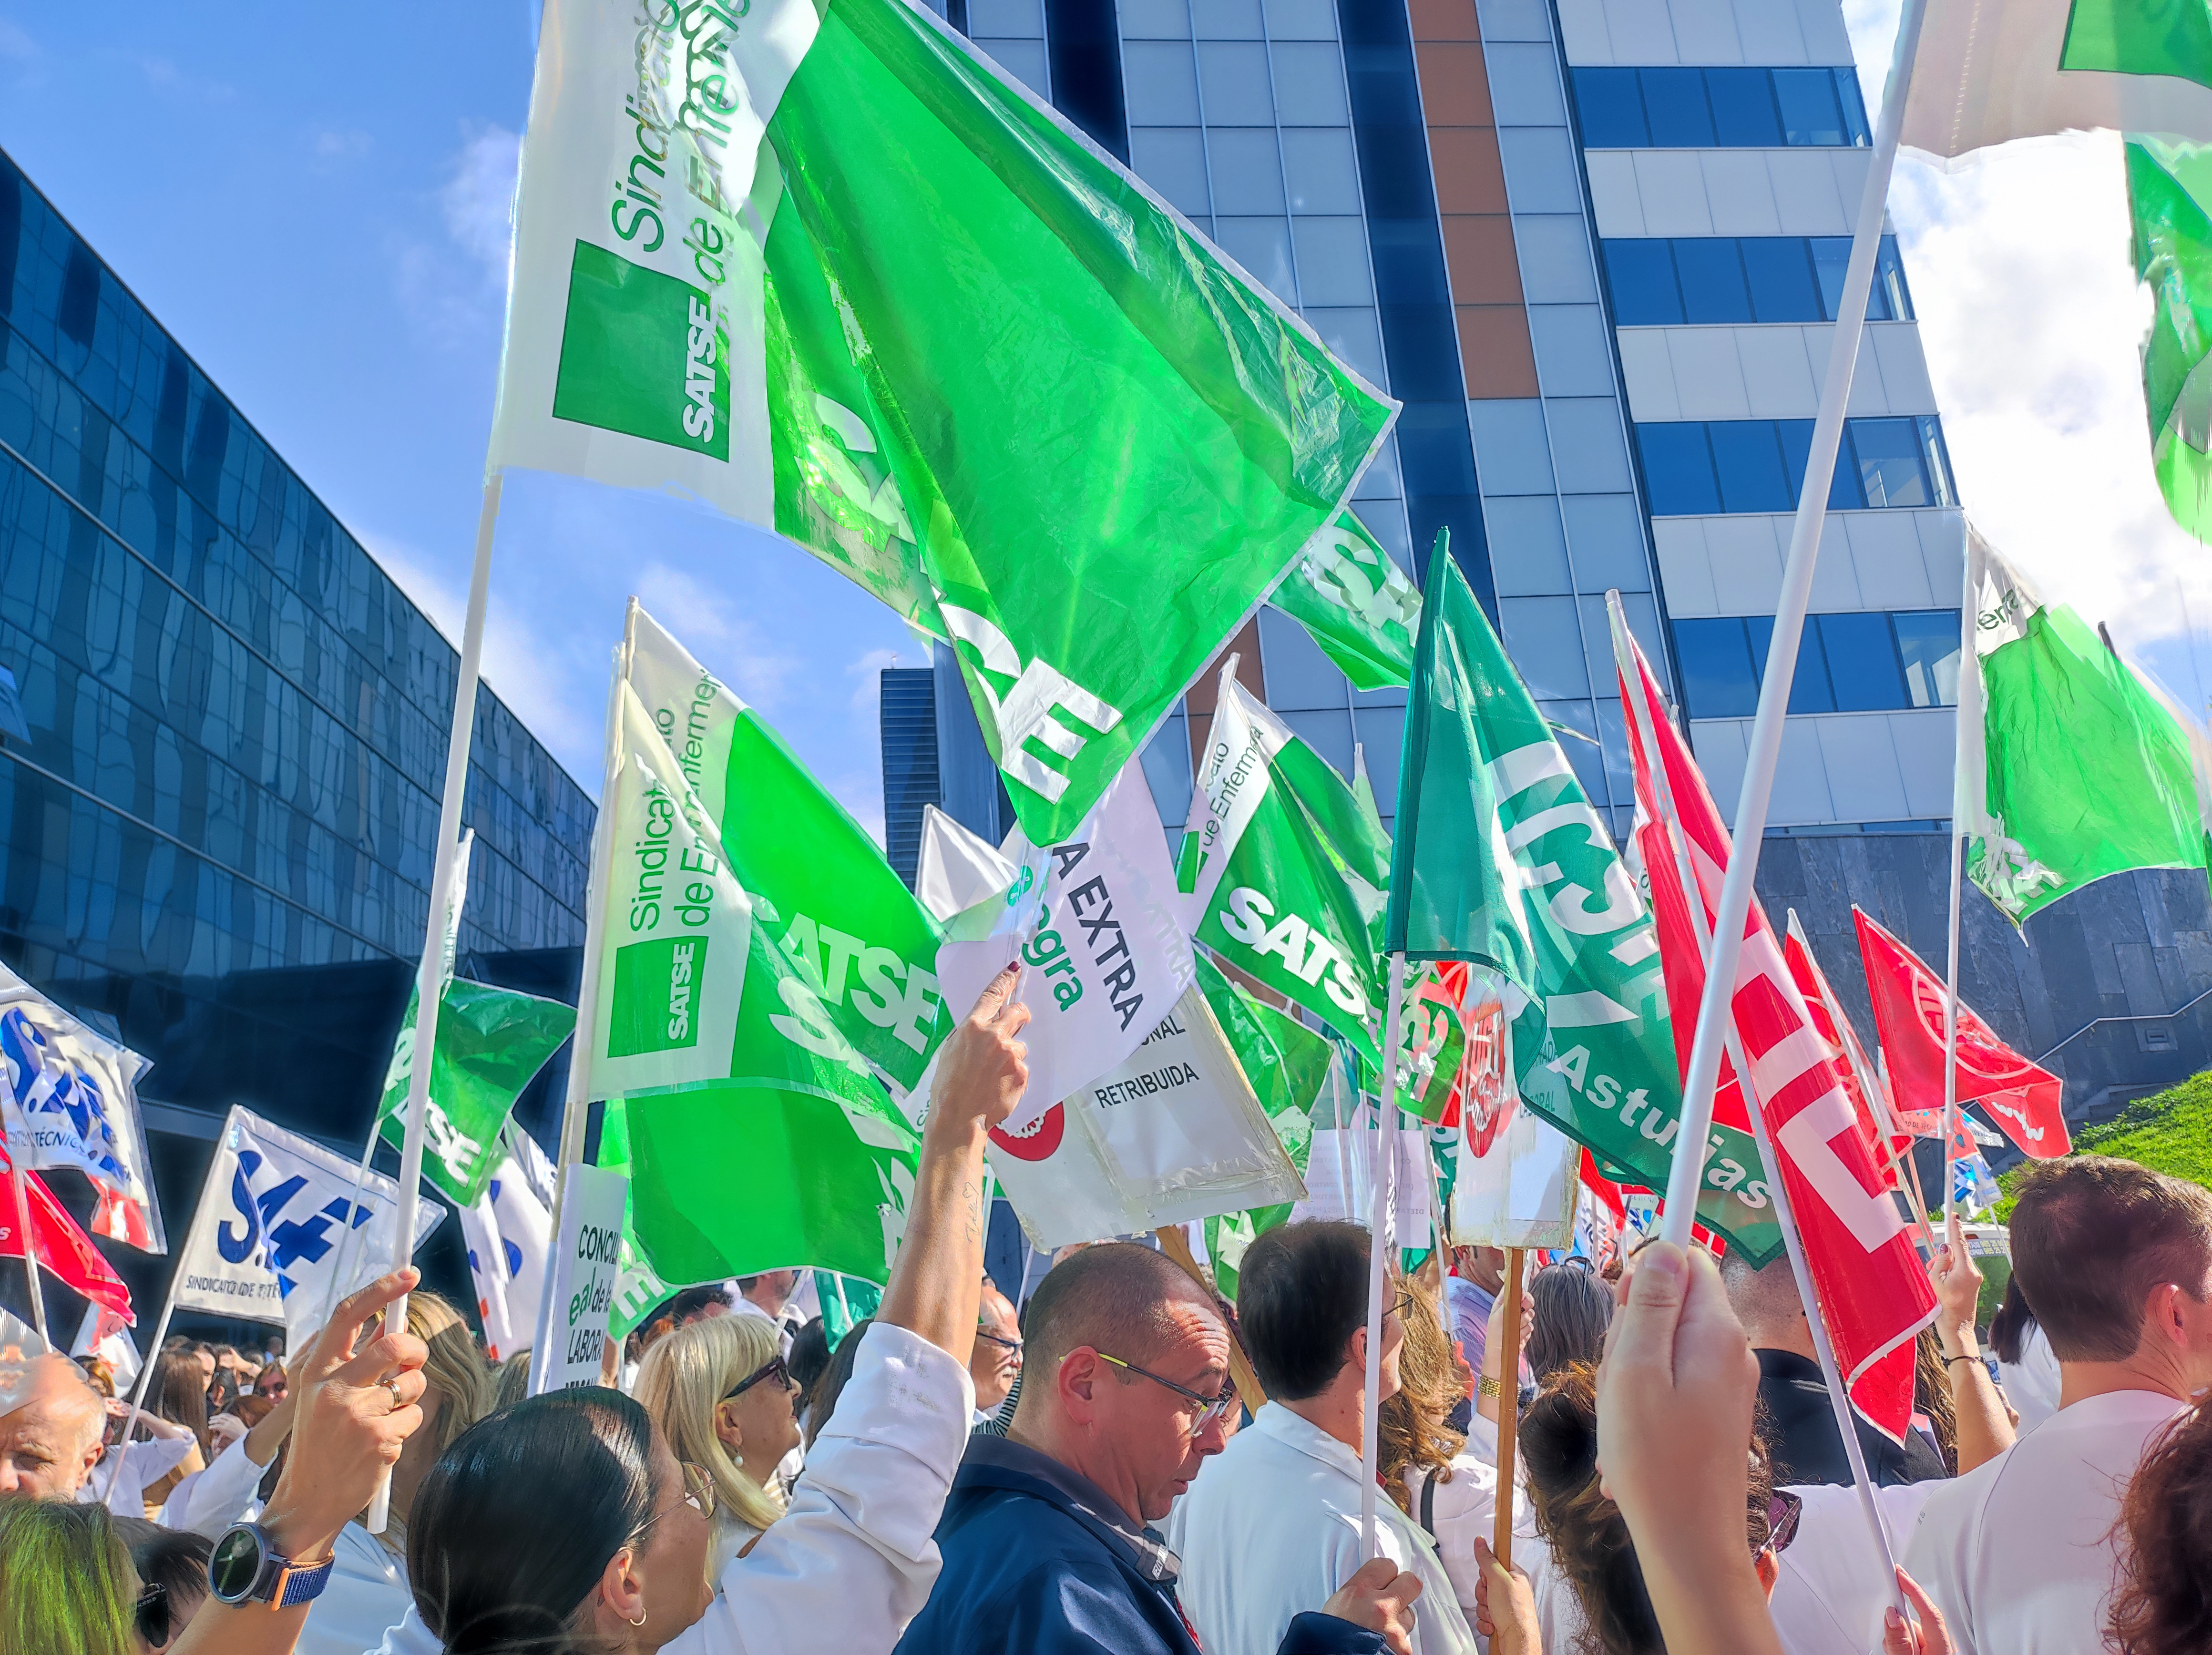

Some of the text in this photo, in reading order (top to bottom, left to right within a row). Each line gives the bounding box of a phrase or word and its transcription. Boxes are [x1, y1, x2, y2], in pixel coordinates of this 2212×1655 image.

[683, 295, 716, 443] SATSE
[674, 882, 714, 927] de
[1068, 875, 1143, 1032] EXTRA
[668, 942, 696, 1041] SATSE
[1095, 1062, 1200, 1109] RETRIBUIDA
[1545, 1043, 1773, 1209] Astuias
[569, 1266, 597, 1322] eal
